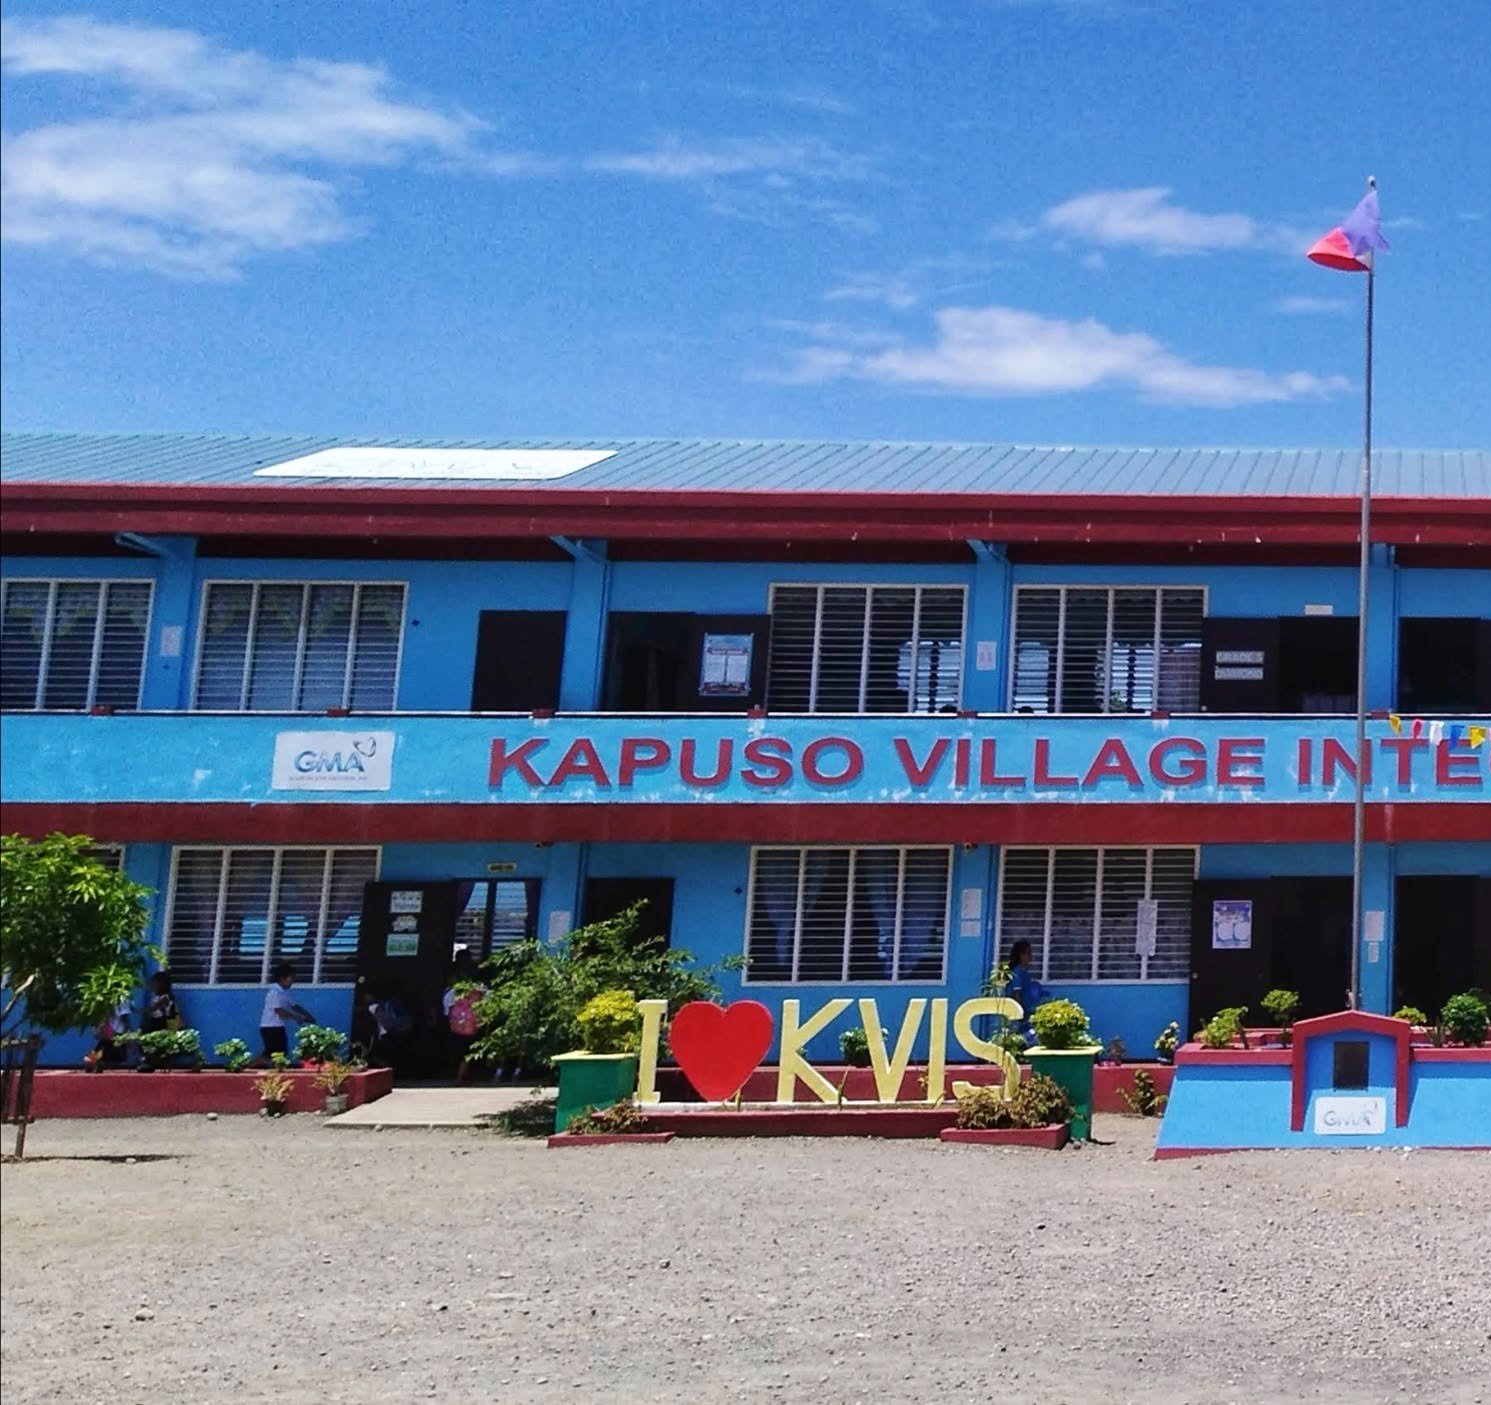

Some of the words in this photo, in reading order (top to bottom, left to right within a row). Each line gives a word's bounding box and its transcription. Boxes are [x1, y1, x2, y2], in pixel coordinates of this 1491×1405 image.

[294, 750, 366, 772] GMA
[488, 737, 864, 787] KAPUSO
[893, 737, 1266, 787] VILLAGE
[776, 998, 1024, 1103] KVIS
